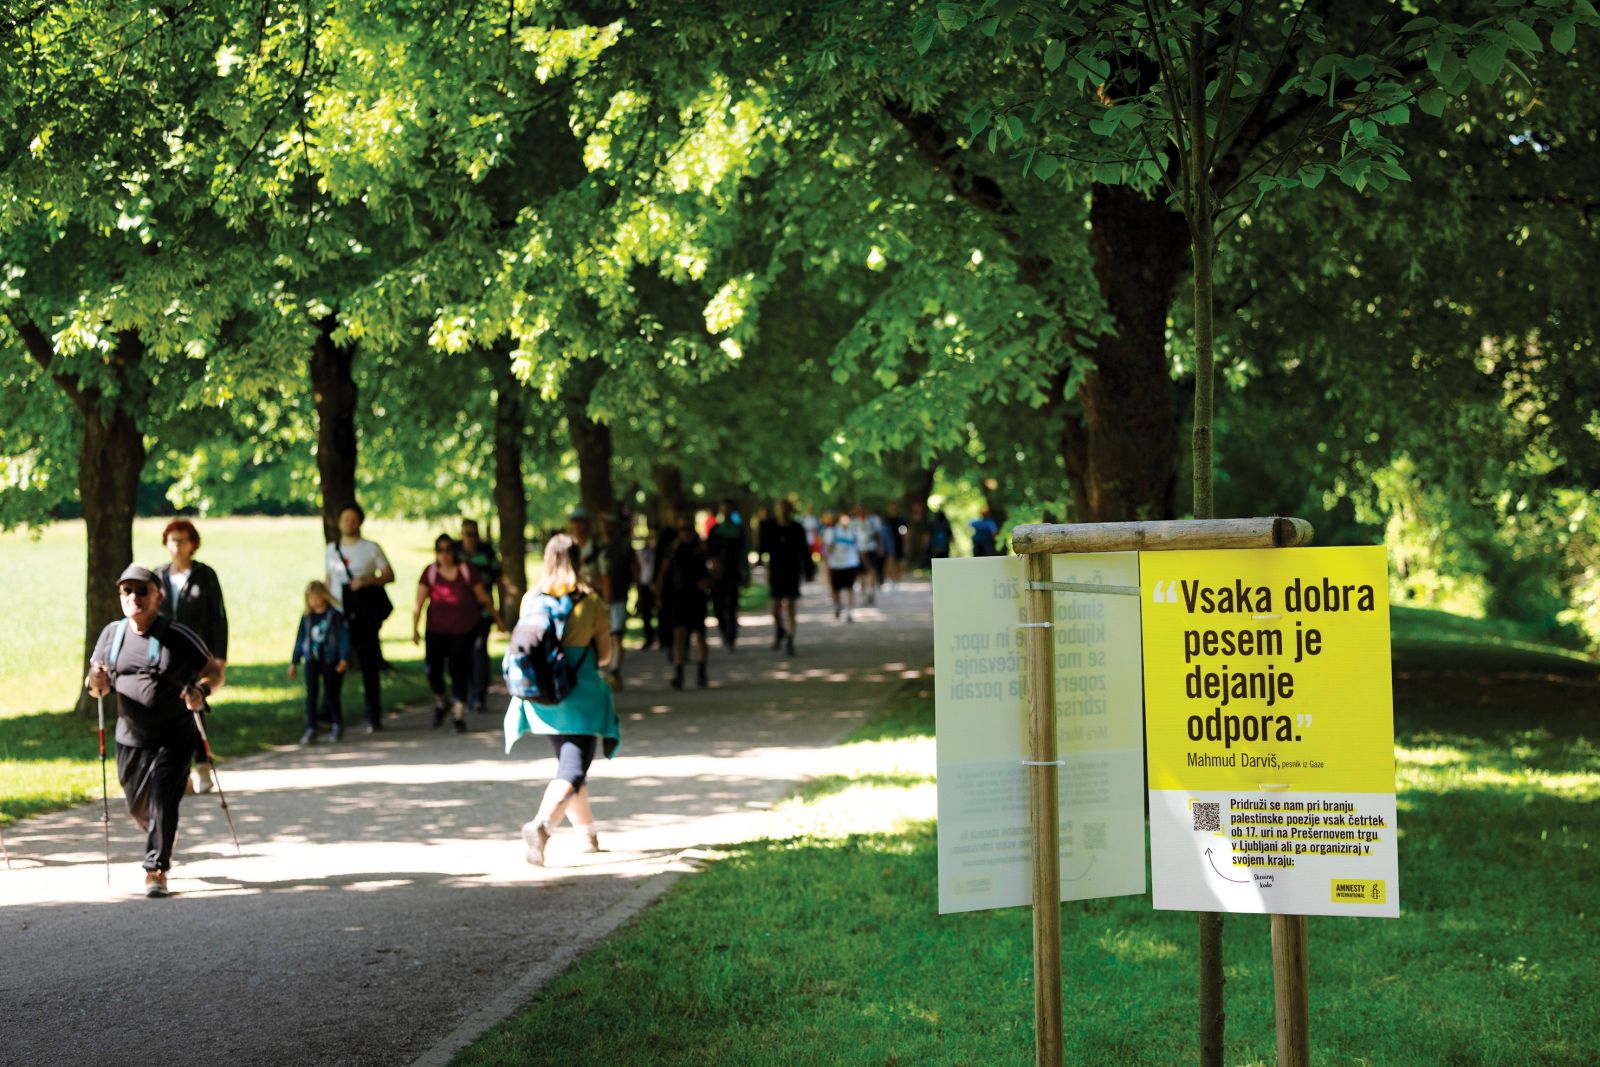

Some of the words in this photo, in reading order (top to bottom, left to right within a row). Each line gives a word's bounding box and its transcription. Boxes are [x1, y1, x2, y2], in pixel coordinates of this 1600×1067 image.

[1285, 577, 1375, 612] dobra
[1184, 628, 1283, 663] pesem
[1294, 621, 1322, 662] je
[1186, 665, 1294, 706] dejanje
[1187, 753, 1236, 768] Mahmud
[1241, 753, 1281, 770] Darviš,
[1281, 760, 1301, 769] pesnik
[1230, 798, 1267, 811] Pridruži
[1269, 802, 1280, 810] se
[1284, 802, 1304, 811] nam
[1307, 800, 1320, 813] pri
[1323, 801, 1354, 813] branju
[1230, 813, 1284, 826] palestinske
[1286, 815, 1320, 827] poezije
[1323, 815, 1345, 826] vsak
[1348, 815, 1384, 826] četrtek
[1231, 827, 1242, 838] ob
[1246, 827, 1258, 838] 17.
[1261, 828, 1274, 838] uri
[1276, 830, 1288, 838] na
[1291, 827, 1354, 840] Prešernovem
[1357, 829, 1378, 842] trgu
[1232, 842, 1236, 850] v
[1239, 840, 1278, 853] Ljubljani
[1280, 841, 1293, 852] ali
[1295, 843, 1307, 855] ga
[1310, 842, 1361, 856] organiziraj
[1364, 845, 1370, 854] v
[1232, 855, 1264, 867] svojem
[1267, 855, 1295, 868] kraju:
[1336, 884, 1365, 892] AMNESTY
